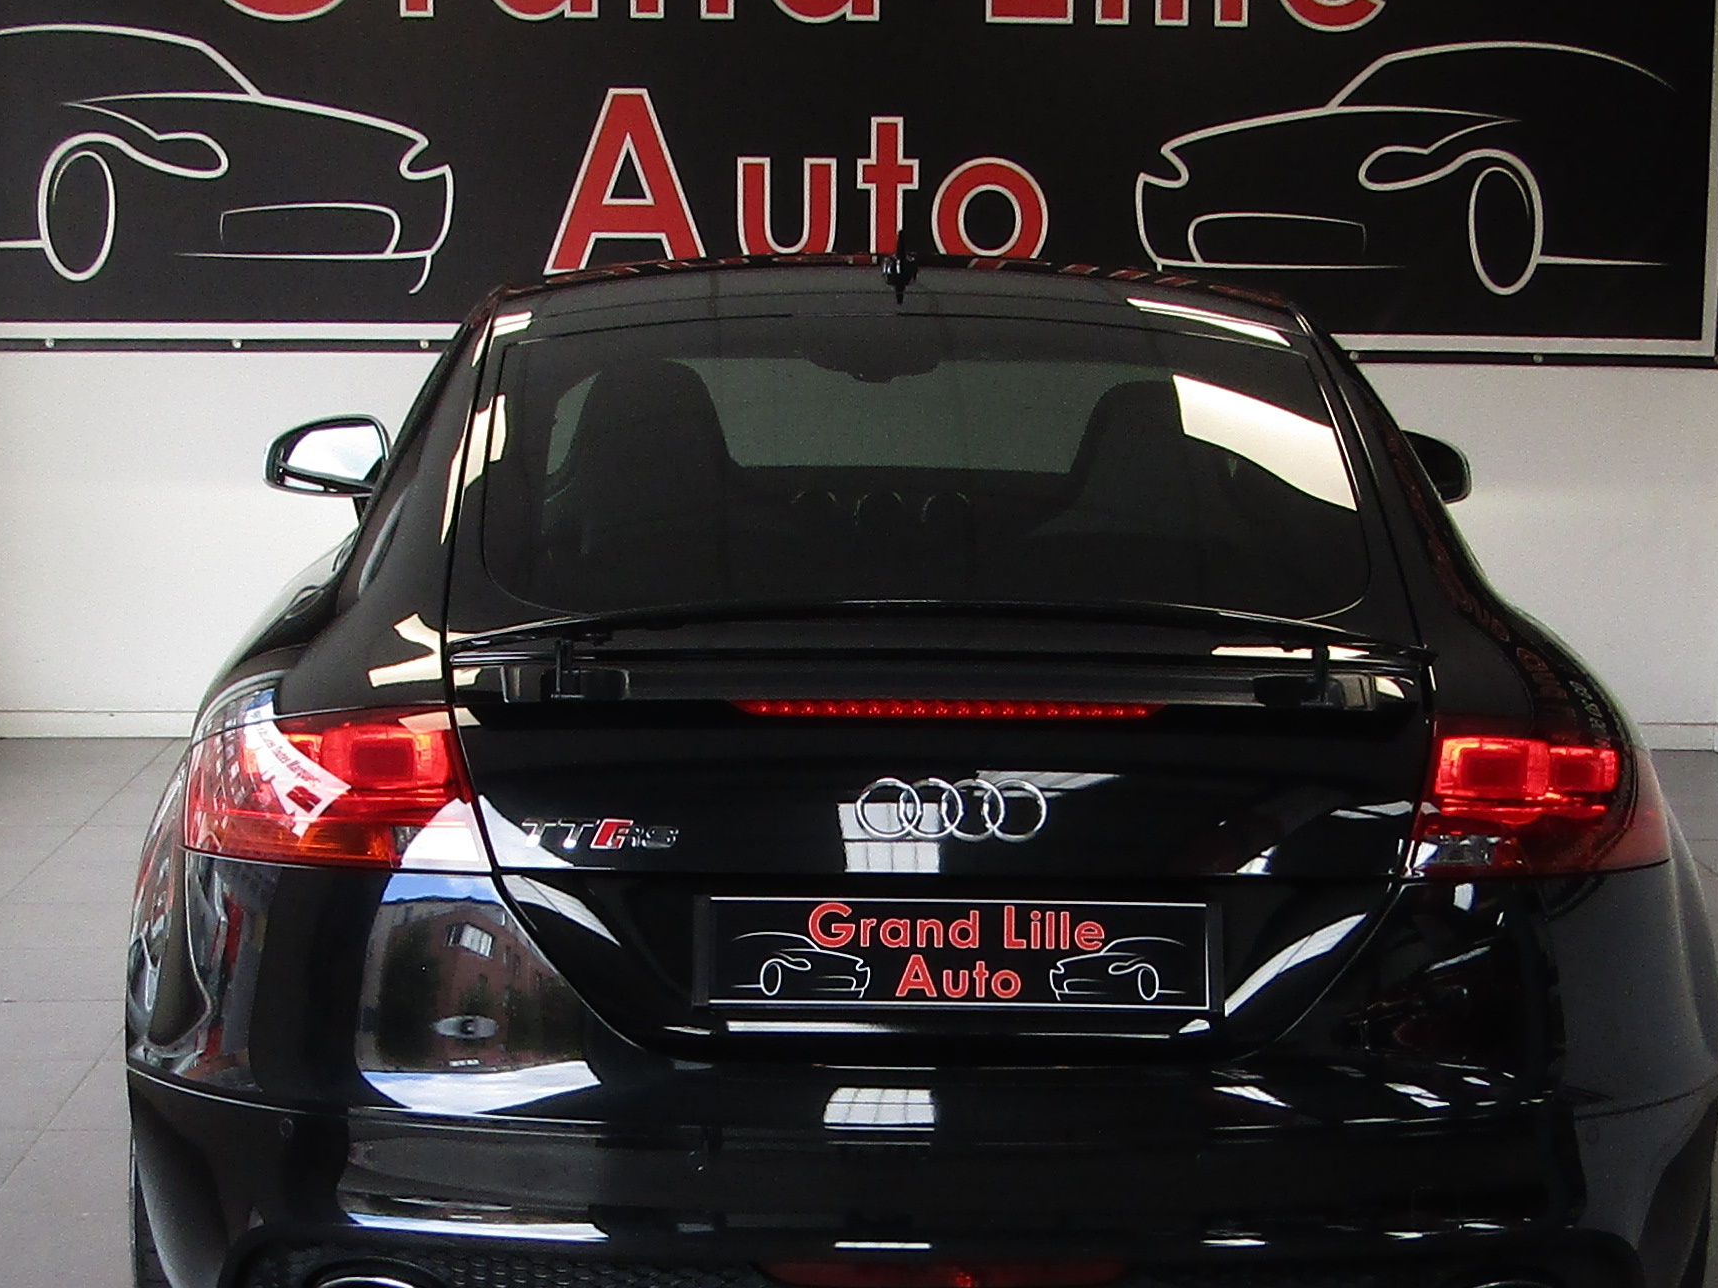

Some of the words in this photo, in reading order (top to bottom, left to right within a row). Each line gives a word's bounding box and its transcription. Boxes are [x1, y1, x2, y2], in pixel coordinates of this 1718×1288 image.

[543, 86, 1050, 277] Auto
[807, 900, 981, 950] Grand
[1002, 903, 1107, 952] Lille
[894, 952, 1023, 1000] Auto
